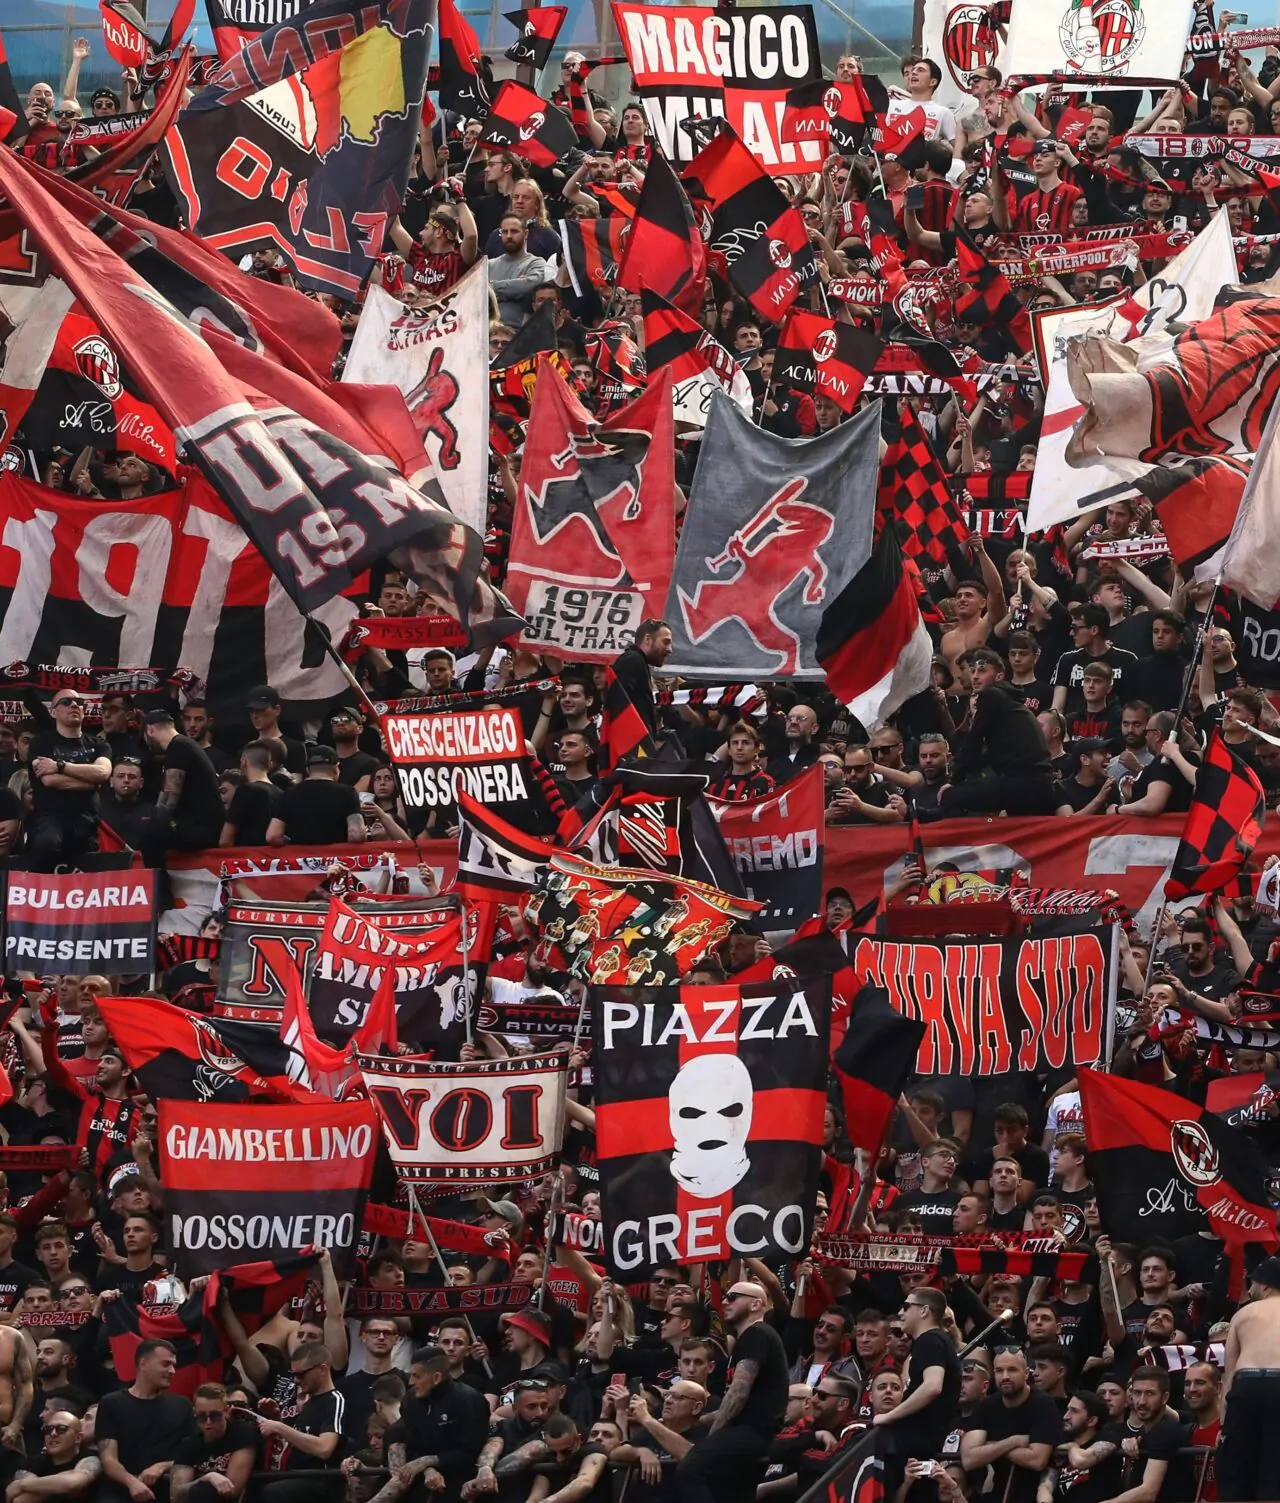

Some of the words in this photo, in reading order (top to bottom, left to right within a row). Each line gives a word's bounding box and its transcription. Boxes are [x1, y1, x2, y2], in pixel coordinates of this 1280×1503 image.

[622, 11, 809, 80] MAGICO
[1155, 138, 1187, 157] 18
[1226, 149, 1260, 173] SUD
[1010, 169, 1036, 183] MILAN
[1086, 226, 1134, 242] MILAN
[1042, 250, 1110, 272] LIVERPOOL
[82, 342, 114, 361] ACM
[780, 364, 803, 380] AC
[803, 366, 850, 396] MILAN
[539, 586, 634, 625] 1976
[523, 613, 636, 651] ULTRAS
[37, 670, 92, 691] 1899
[386, 710, 518, 759] CRESCENZAGO
[397, 760, 528, 808] ROSSONERA
[7, 885, 149, 910] BULGARIA
[235, 910, 305, 925] CURVA
[6, 936, 148, 960] PRESENTE
[311, 951, 443, 993] AMORE
[1016, 933, 1105, 1072] SUD
[602, 990, 819, 1050] PIAZZA
[479, 1056, 560, 1073] MILANO
[368, 1084, 545, 1152] NOI
[165, 1123, 372, 1162] GIAMBELLINO
[445, 1157, 555, 1178] PRESENTI
[909, 1203, 952, 1216] adidas
[612, 1204, 805, 1271] GRECO
[352, 1289, 450, 1311] URVA
[459, 1285, 531, 1306] SUD
